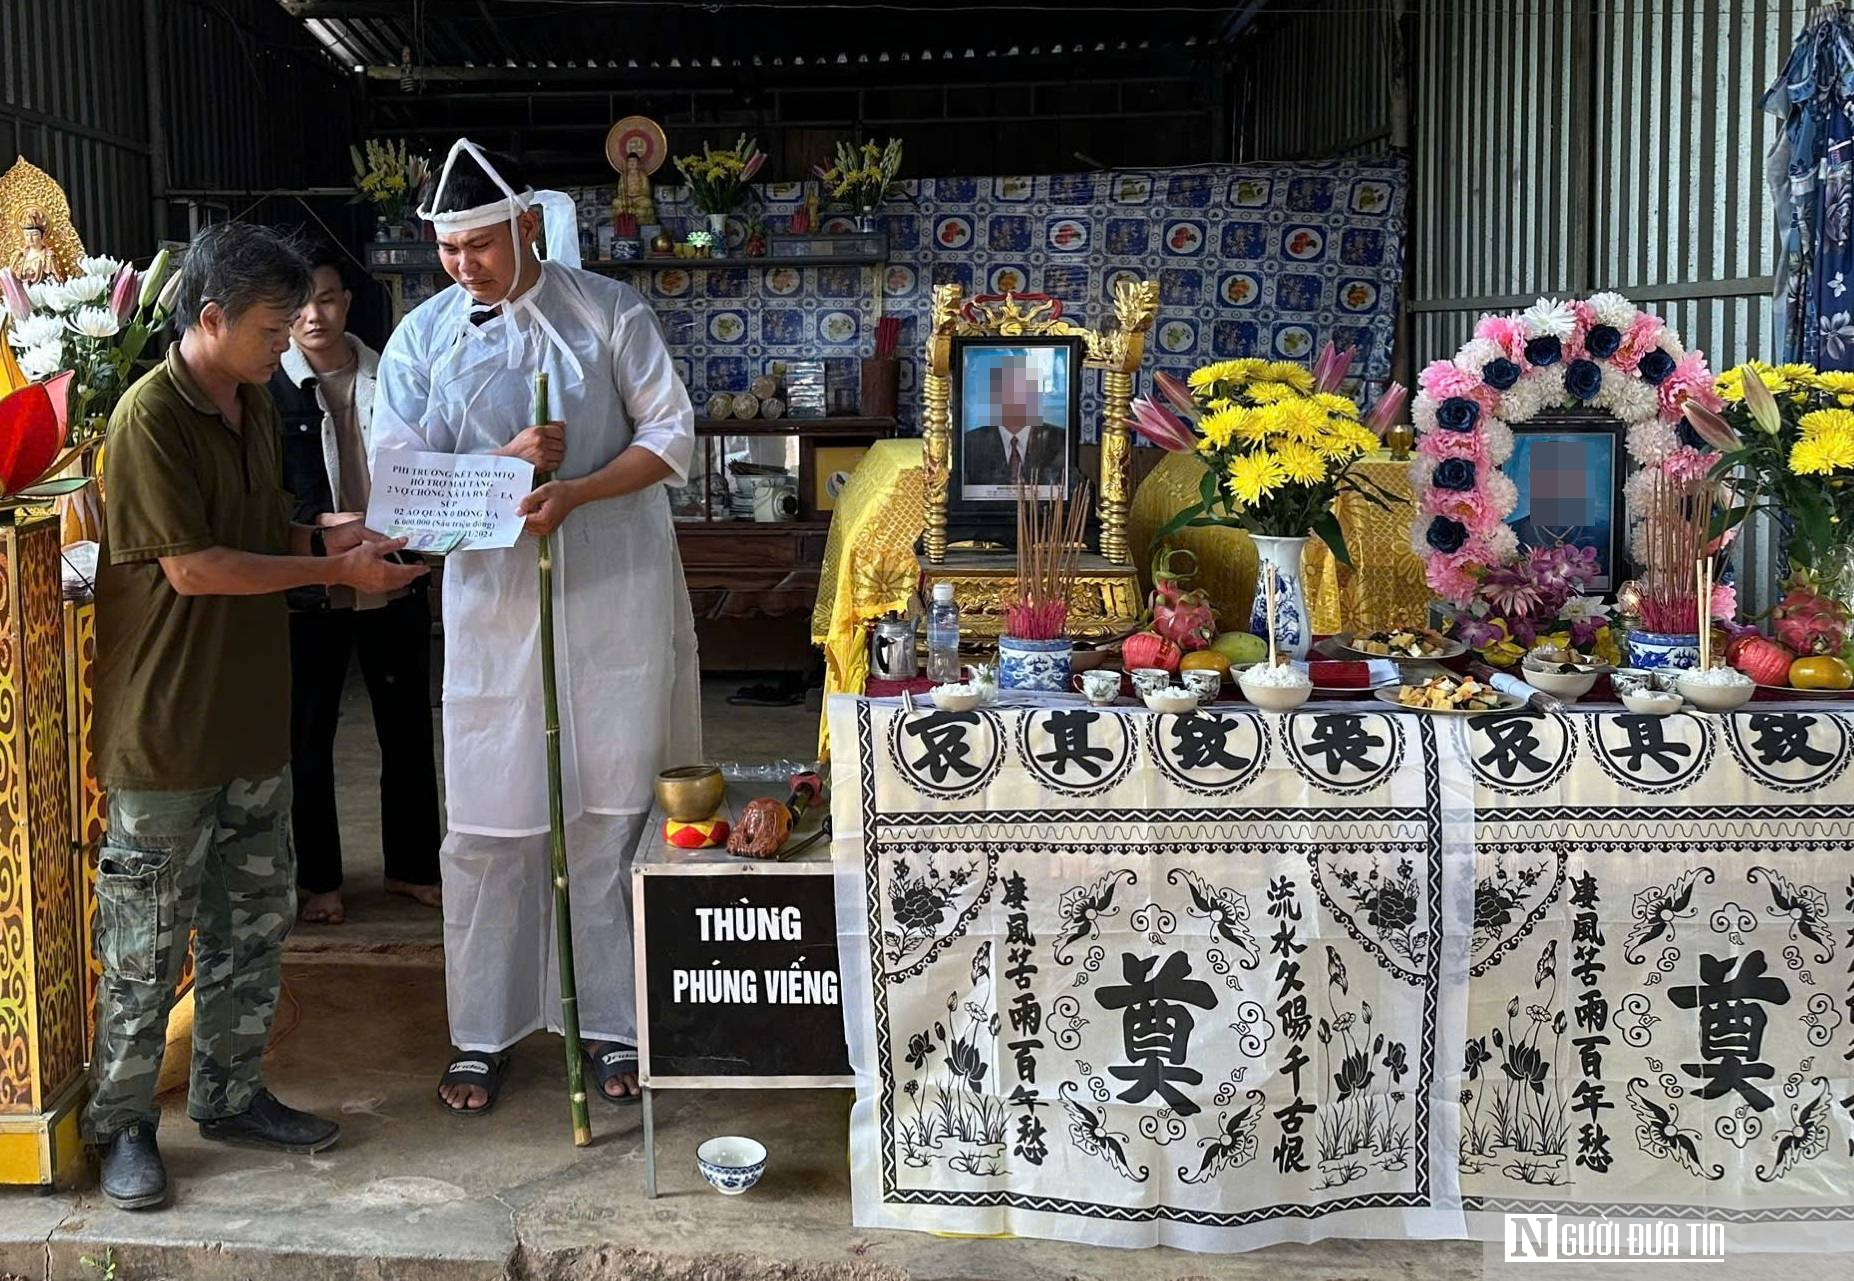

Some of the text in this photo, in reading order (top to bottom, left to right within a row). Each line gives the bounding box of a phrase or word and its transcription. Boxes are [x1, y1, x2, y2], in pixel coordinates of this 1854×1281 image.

[387, 485, 392, 494] 2
[394, 508, 404, 516] 02
[695, 897, 802, 941] THÙNG
[672, 955, 839, 1004] PHÚNG VIẾNG
[1097, 950, 1219, 1115] 奠
[1667, 950, 1791, 1112] 奠
